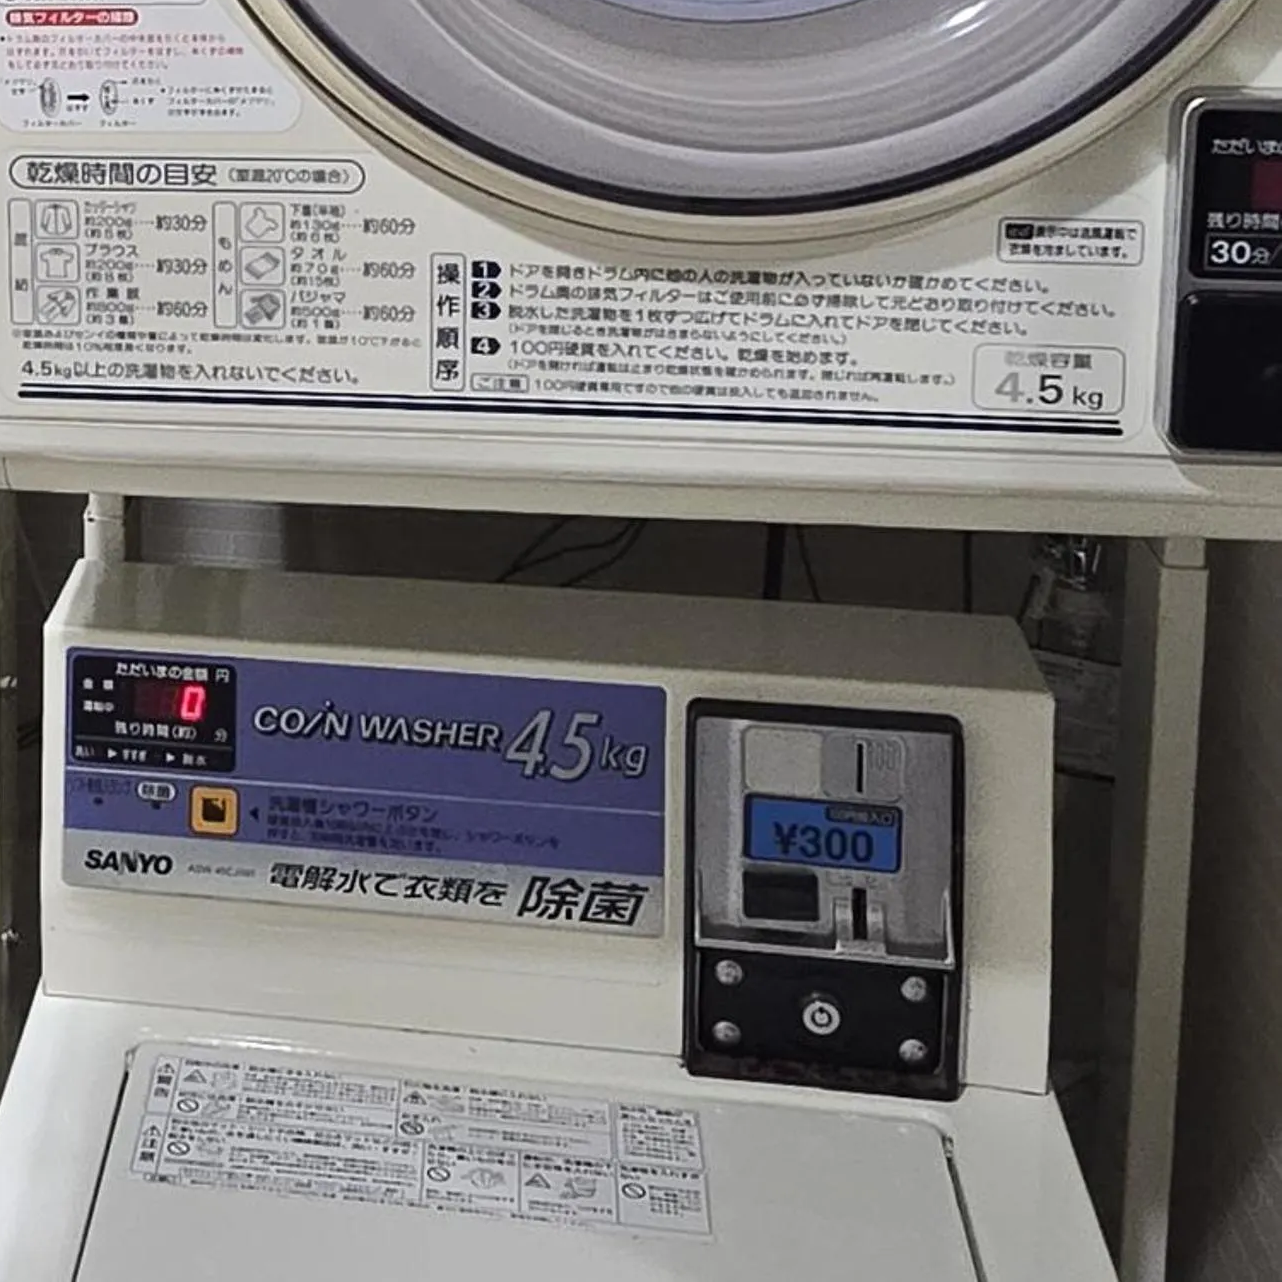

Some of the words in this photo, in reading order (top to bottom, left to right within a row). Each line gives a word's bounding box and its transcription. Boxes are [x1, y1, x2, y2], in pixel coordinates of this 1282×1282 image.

[26, 161, 218, 187] 乾燥時間の目安
[156, 214, 208, 232] 約30分
[1207, 212, 1282, 231] 残り時間
[85, 244, 139, 258] ブラウス
[156, 257, 208, 275] 約30分
[435, 263, 461, 382] 操作順序
[215, 668, 230, 683] 円
[180, 685, 206, 721] 0
[359, 716, 503, 752] WASHER
[773, 821, 874, 863] ¥300
[84, 848, 174, 876] SANYO
[269, 863, 509, 908] 電解水で衣類を
[517, 876, 650, 926] 除菌
